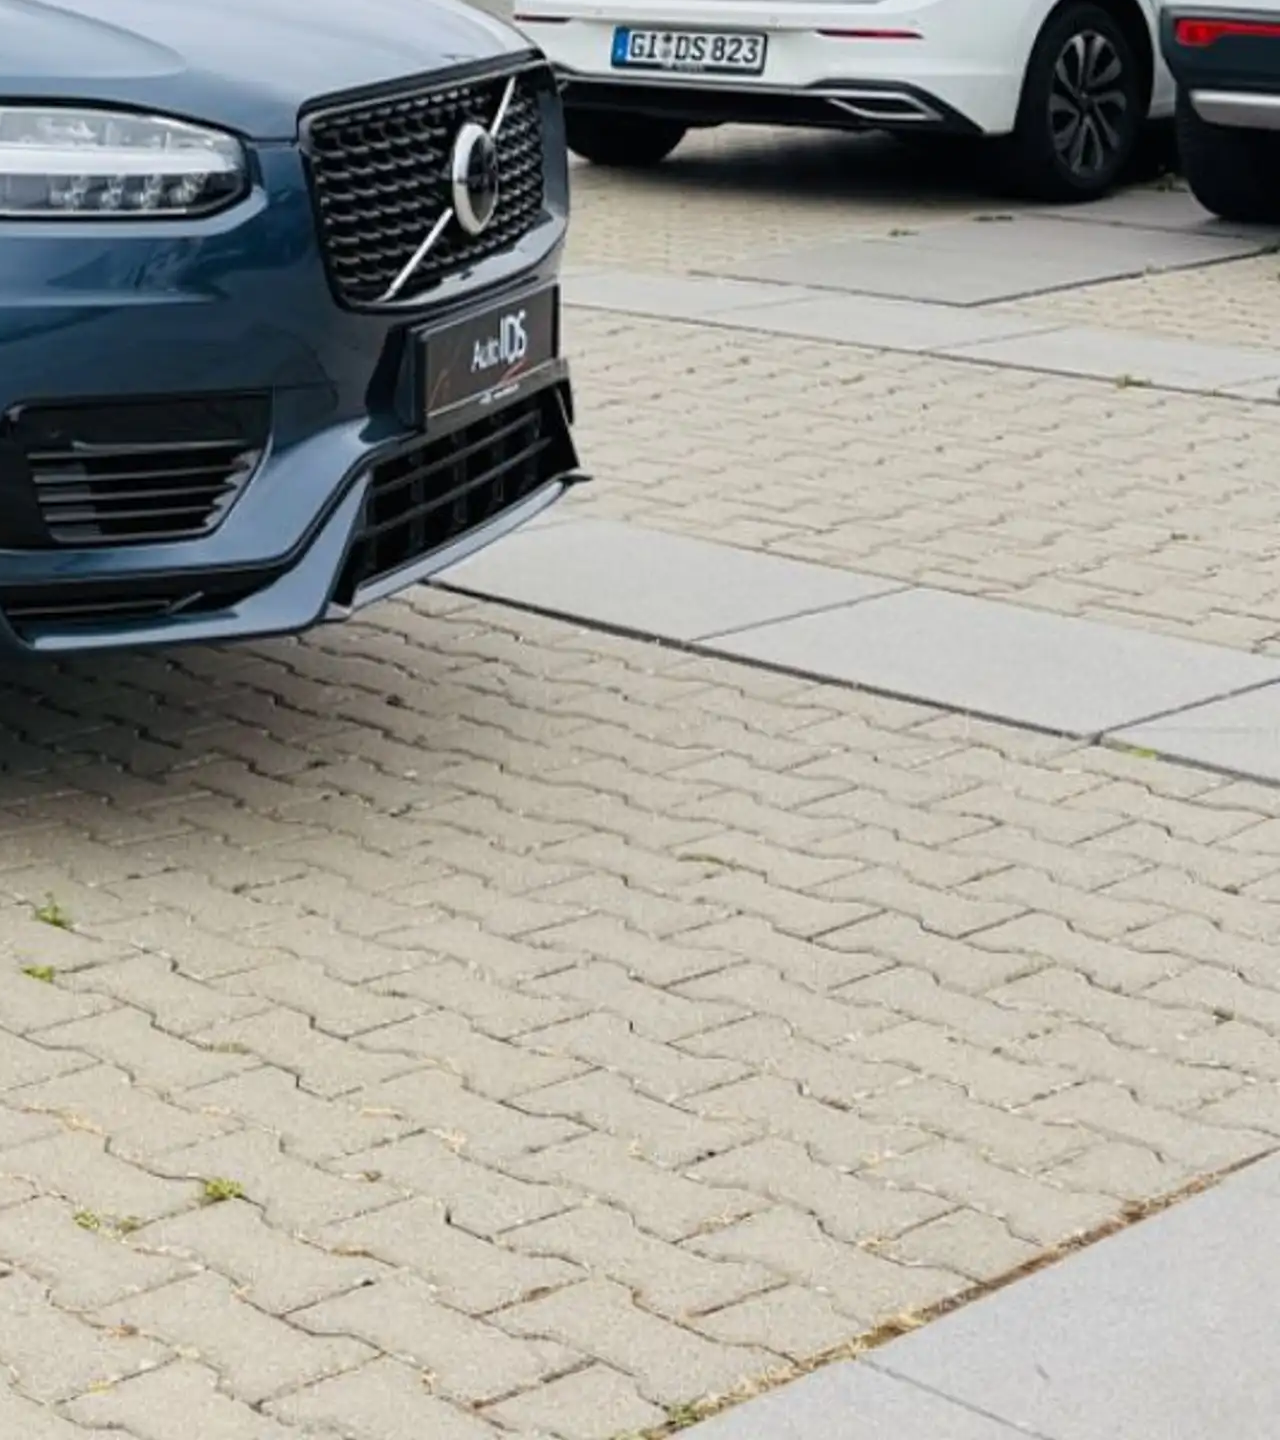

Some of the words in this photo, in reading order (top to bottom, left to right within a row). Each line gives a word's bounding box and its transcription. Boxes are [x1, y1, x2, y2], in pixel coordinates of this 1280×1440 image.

[630, 33, 658, 59] GI
[674, 35, 706, 61] DS
[711, 36, 760, 64] 823
